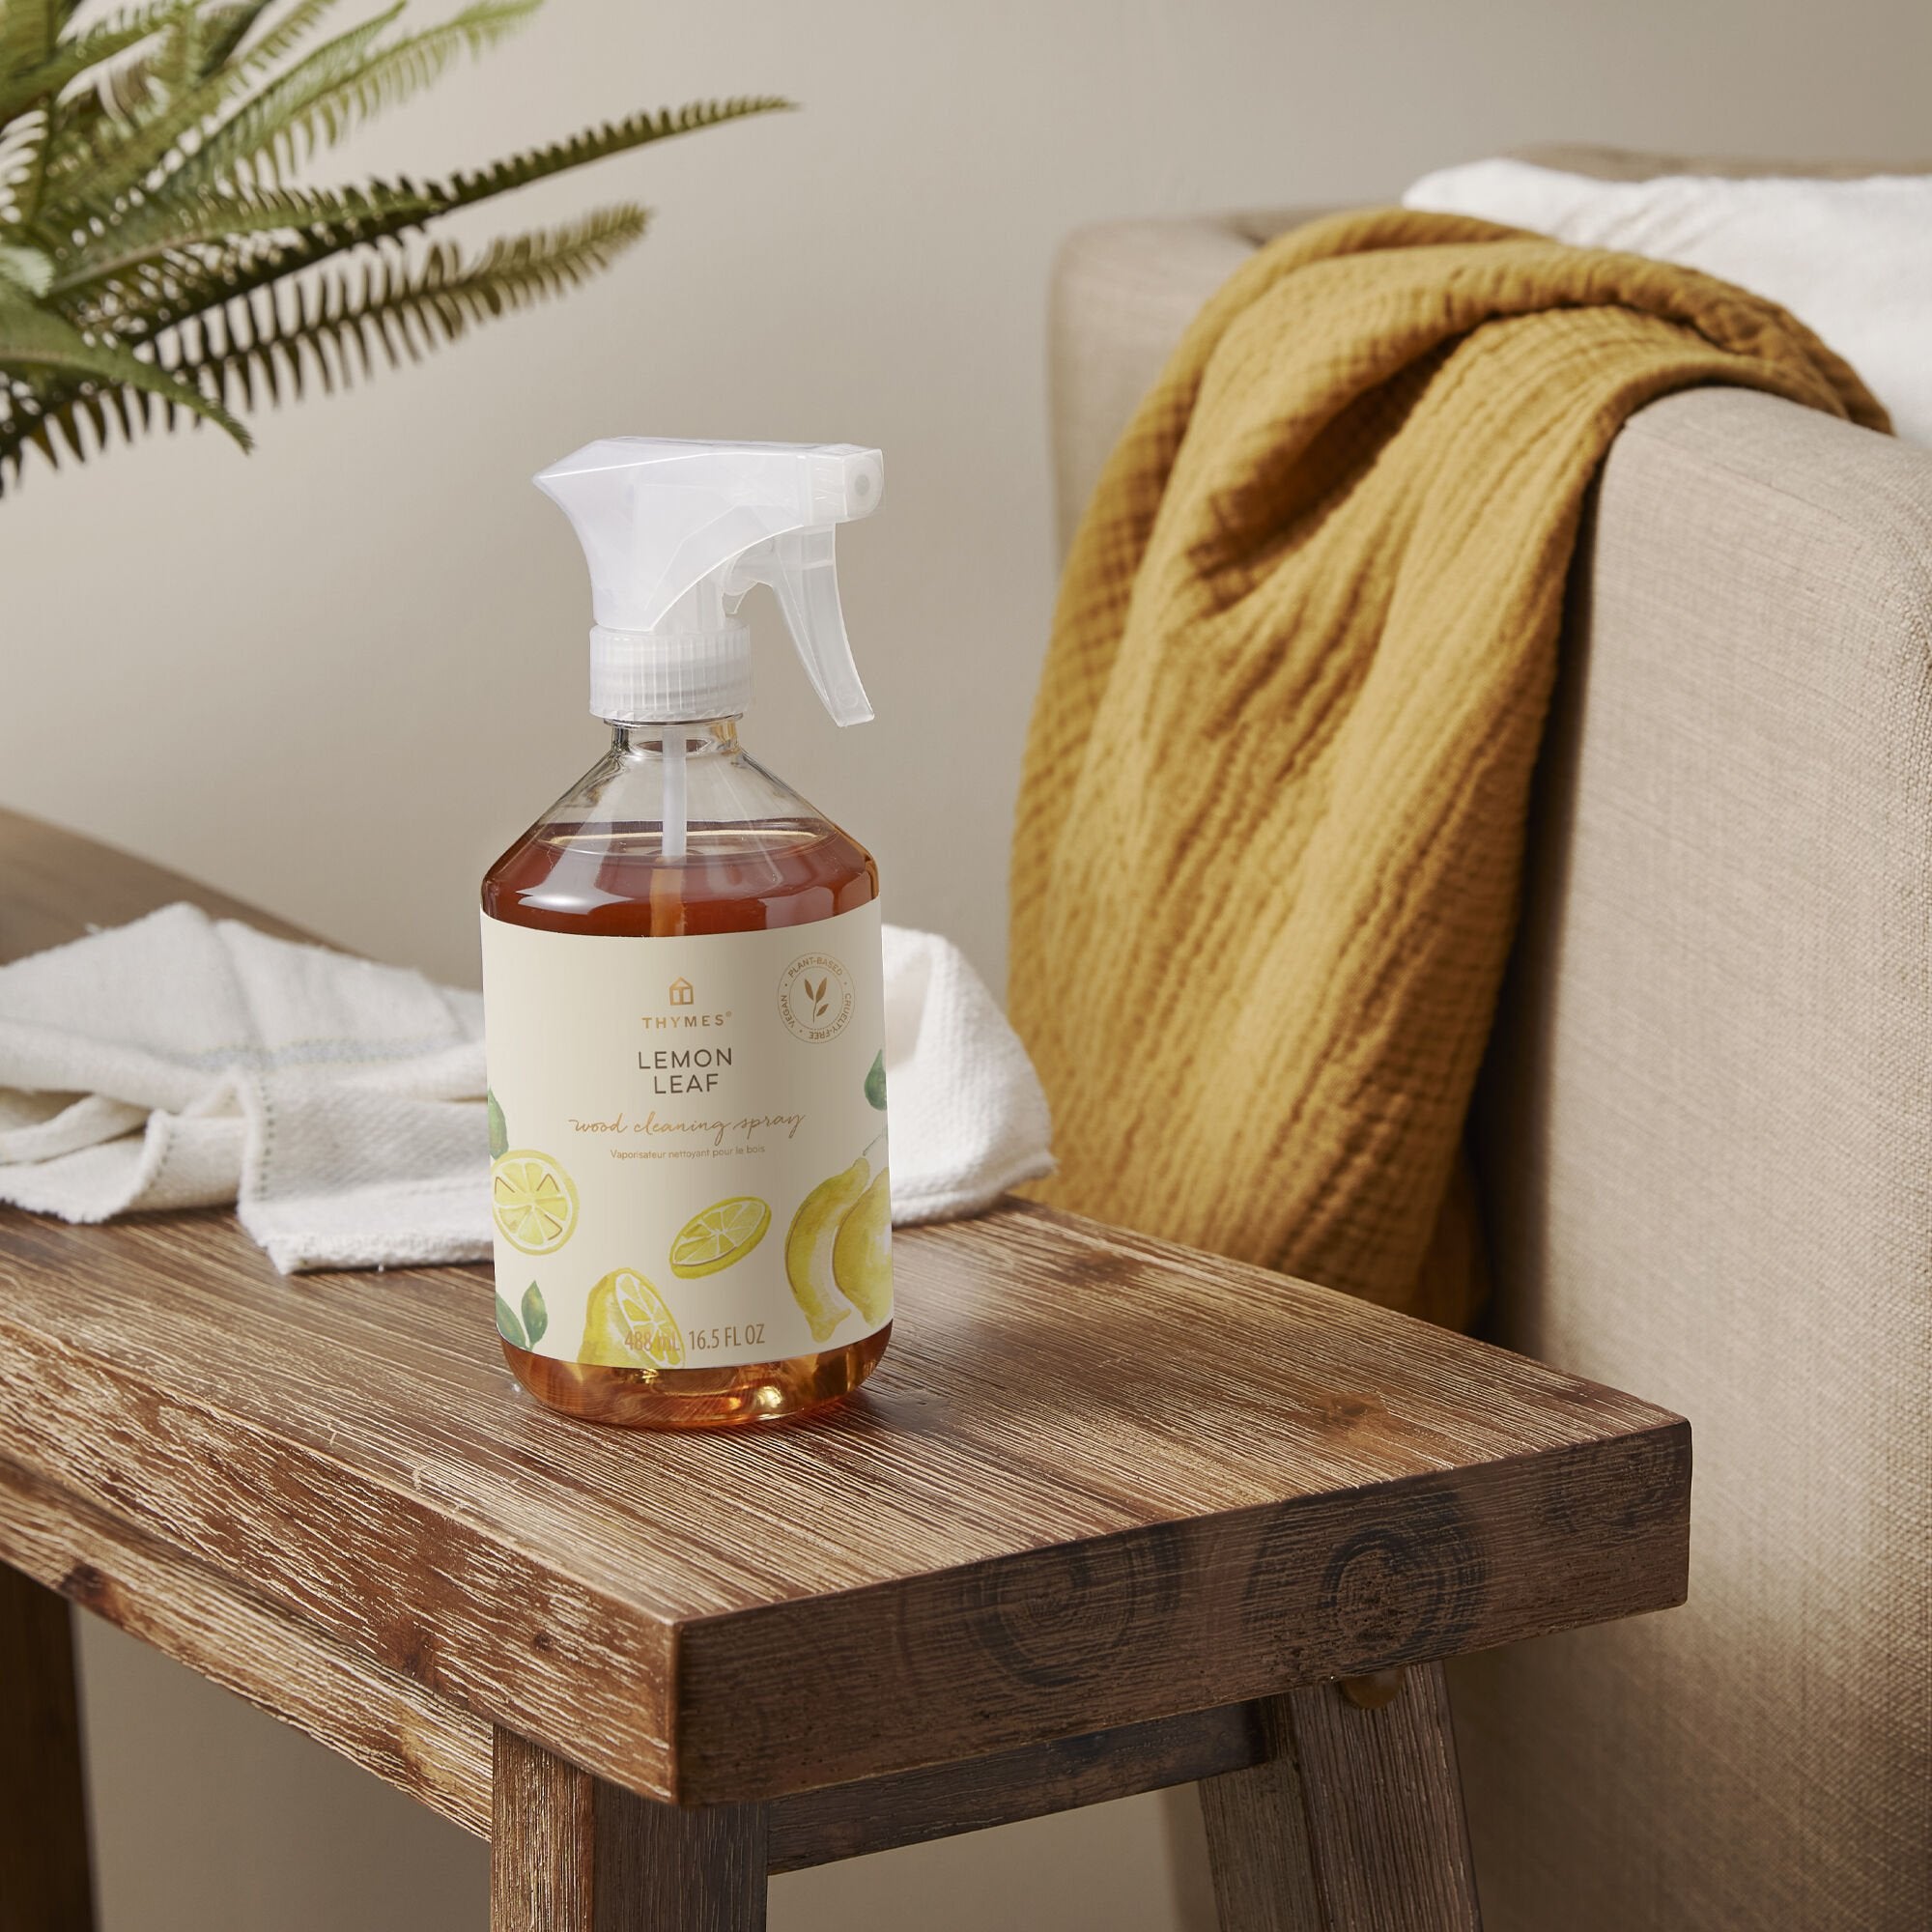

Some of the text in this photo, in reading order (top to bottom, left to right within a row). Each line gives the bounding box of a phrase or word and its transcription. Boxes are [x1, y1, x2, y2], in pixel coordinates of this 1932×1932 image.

[788, 957, 842, 978] PLANT-BASED
[781, 995, 795, 1028] VEGAN
[809, 993, 852, 1040] CRUELTY-FREE
[639, 1047, 732, 1069] LEMON
[654, 1073, 719, 1094] LEAF
[568, 1111, 806, 1147] wood cleaning spray
[611, 1144, 766, 1160] Vaporisateur nettoyant pour le bois
[624, 1331, 653, 1351] 488
[689, 1328, 720, 1350] 16.5
[724, 1326, 741, 1348] FL
[745, 1323, 765, 1345] OZ
